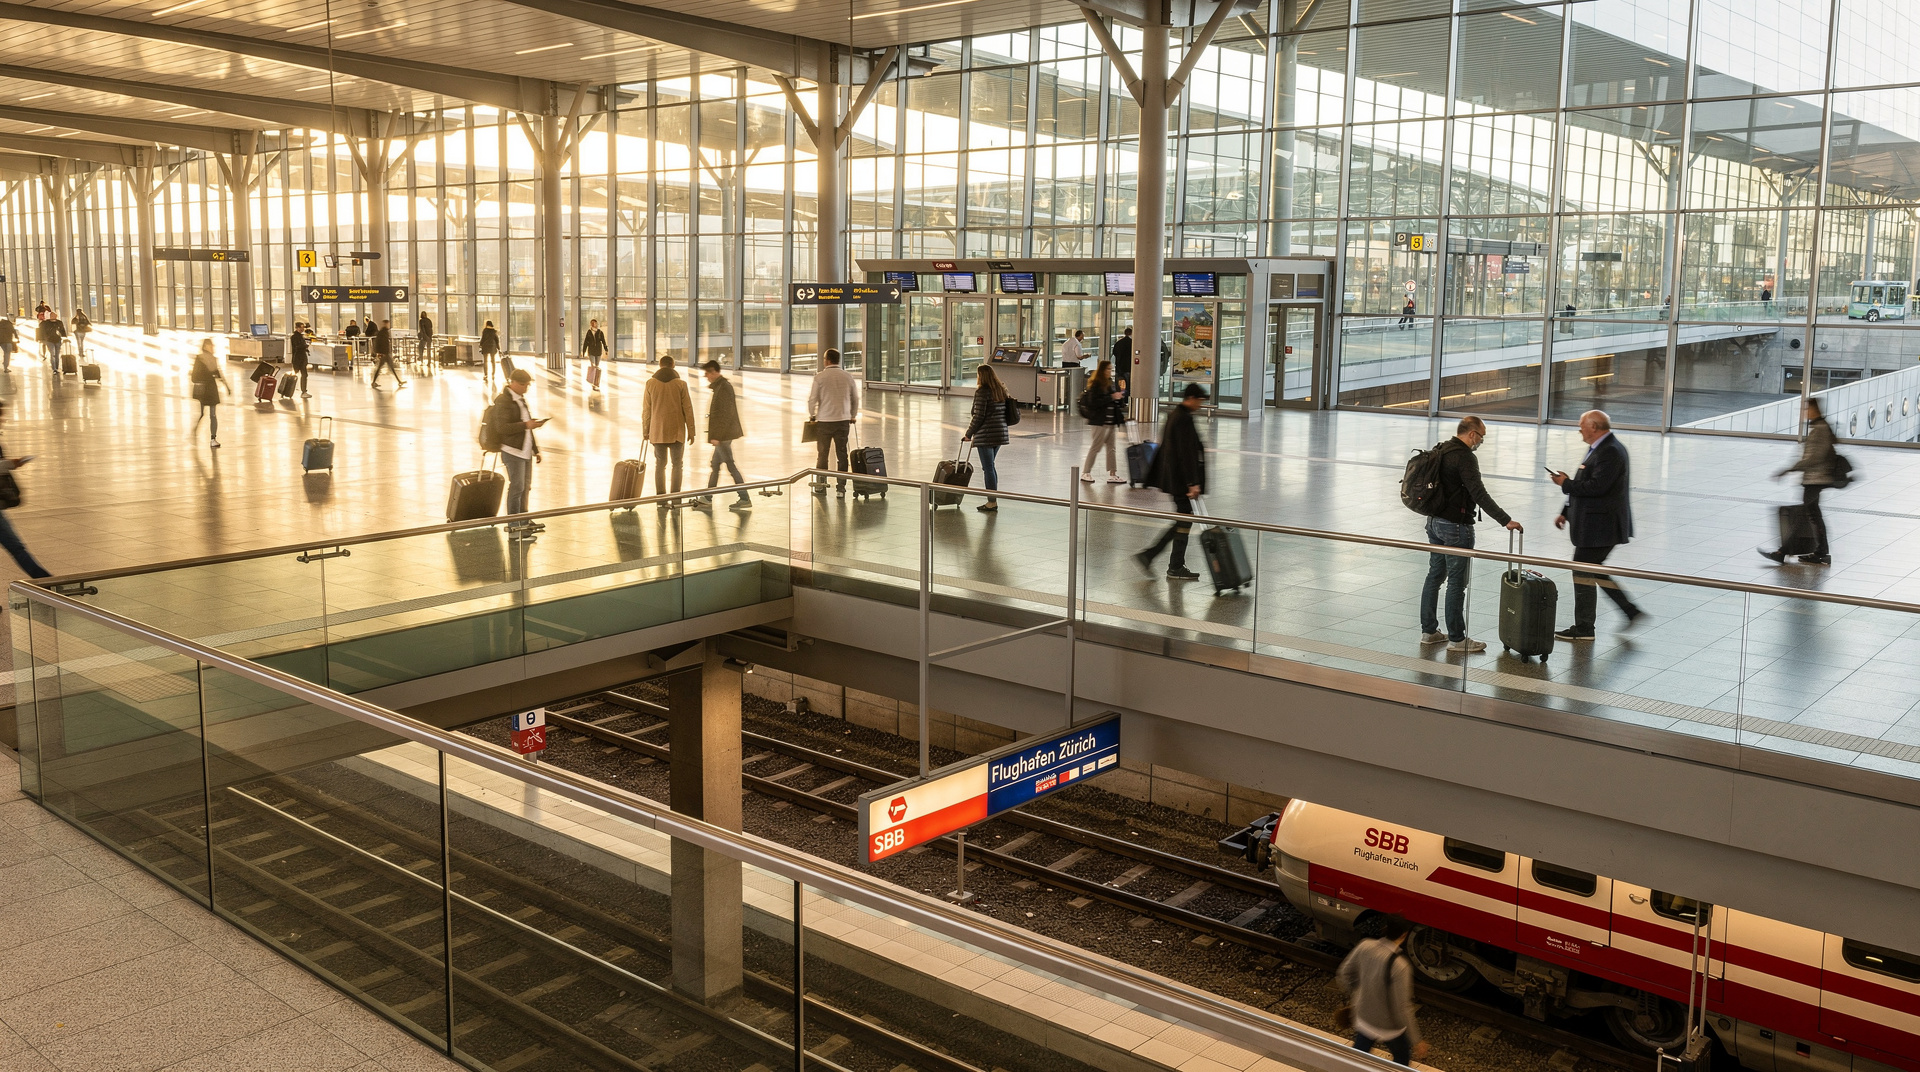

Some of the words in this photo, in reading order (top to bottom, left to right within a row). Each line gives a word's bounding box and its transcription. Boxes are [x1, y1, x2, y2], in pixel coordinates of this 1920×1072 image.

[991, 749, 1055, 784] Flughafen
[1059, 733, 1096, 760] Zürich
[873, 828, 905, 854] SBB
[1364, 827, 1410, 854] SBB
[1393, 857, 1419, 872] Zürich
